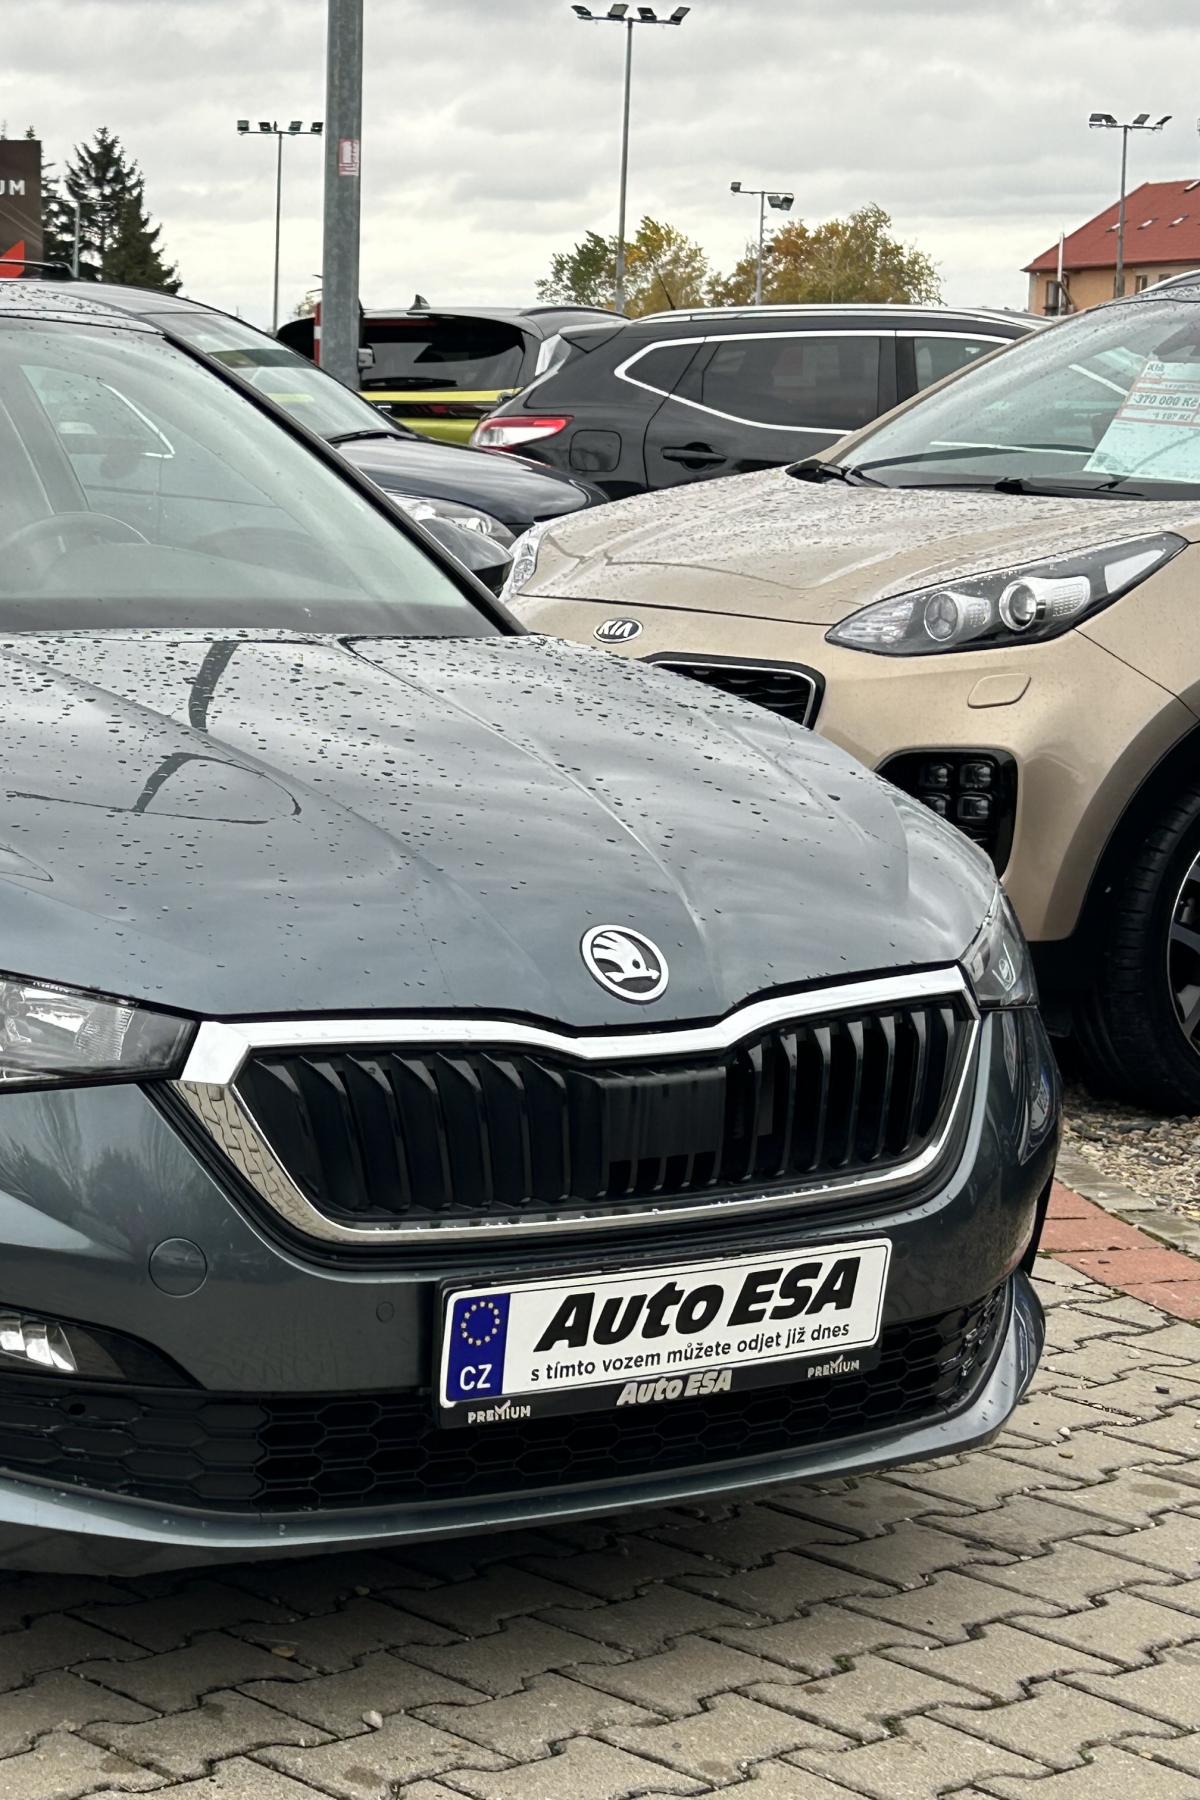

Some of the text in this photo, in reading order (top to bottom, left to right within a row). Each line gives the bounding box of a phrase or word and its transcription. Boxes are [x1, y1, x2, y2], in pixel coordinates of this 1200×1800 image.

[597, 620, 633, 637] KIA
[532, 1256, 861, 1352] Auto ESA
[530, 1323, 850, 1382] s tímto vozem můžete odjet již dnes
[807, 1354, 860, 1379] PREMIUM
[459, 1363, 493, 1391] CZ
[616, 1369, 733, 1406] Auto ESA
[467, 1400, 532, 1424] PREMIUM
